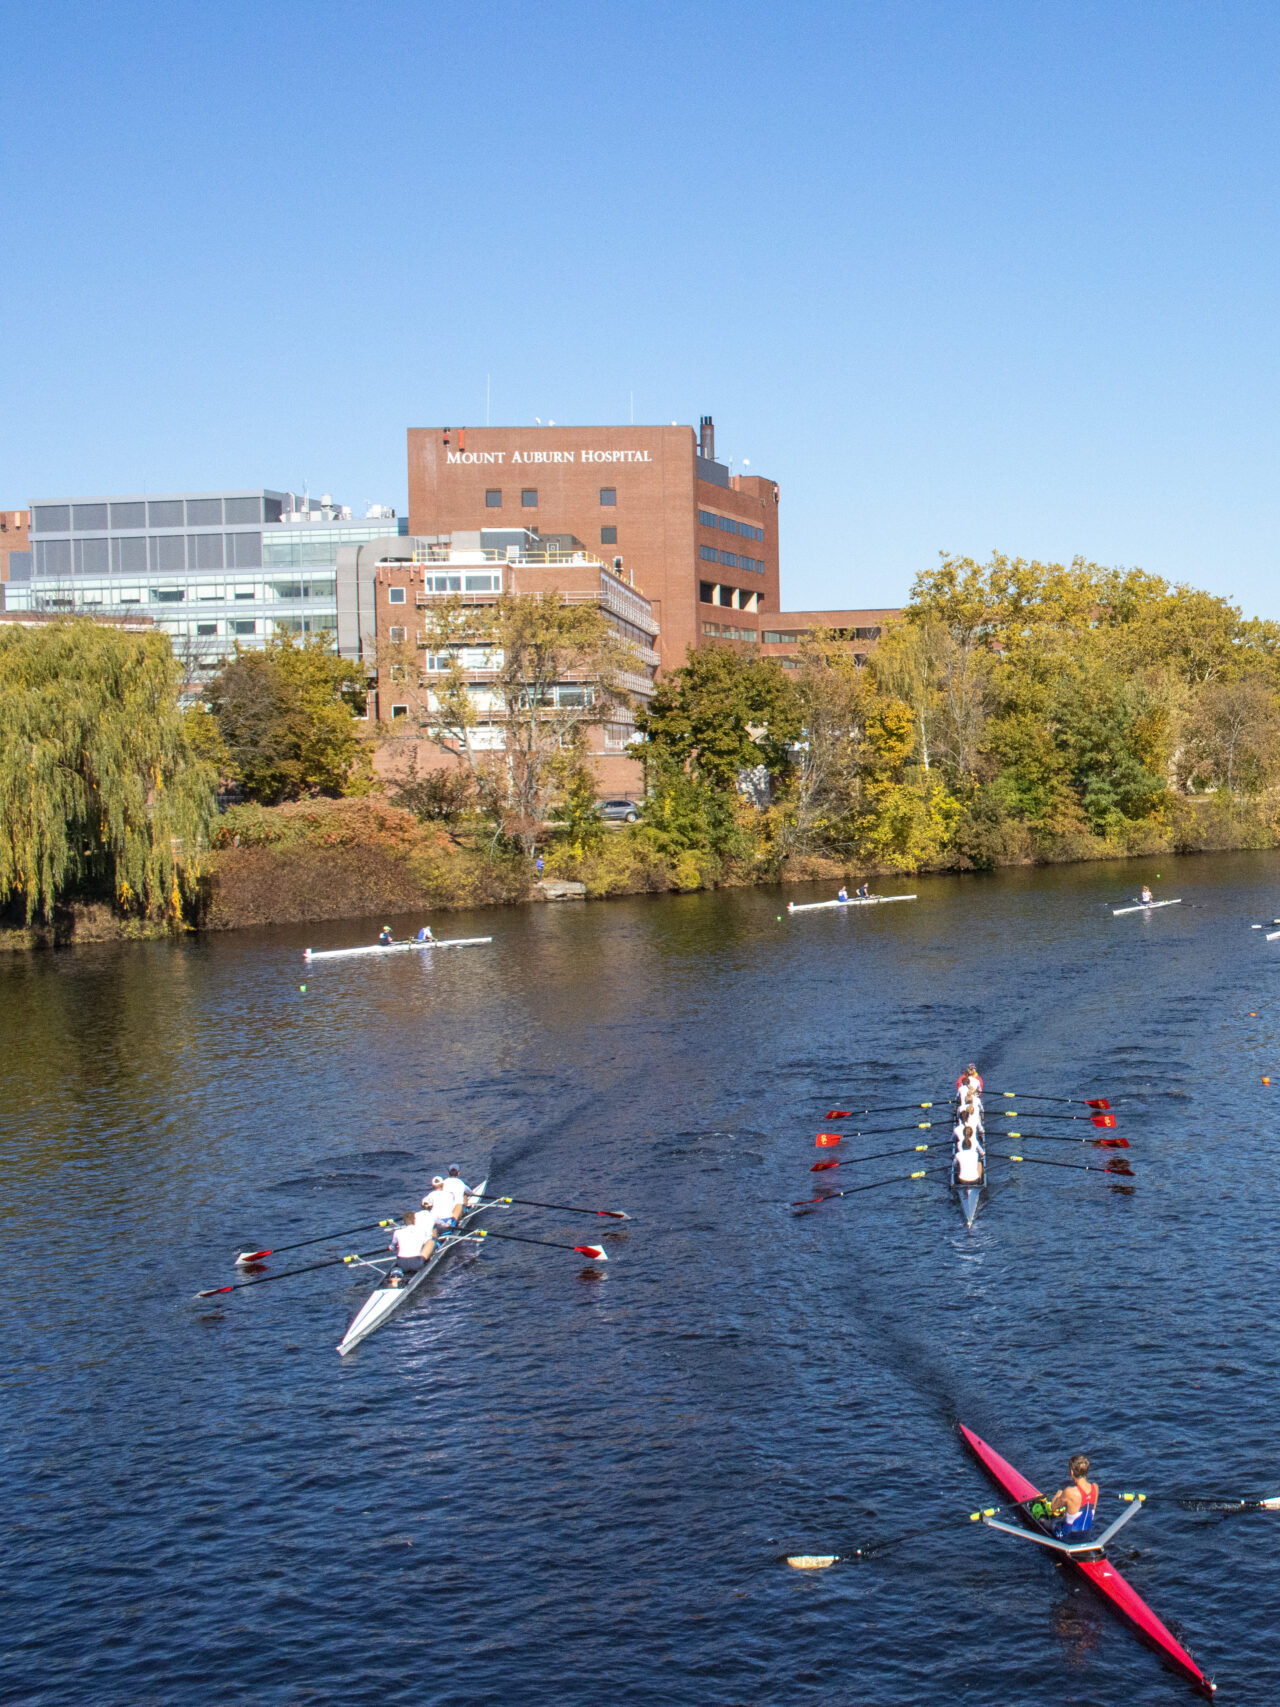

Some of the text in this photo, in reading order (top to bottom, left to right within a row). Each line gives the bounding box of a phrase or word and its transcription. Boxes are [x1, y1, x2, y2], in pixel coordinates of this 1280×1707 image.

[446, 449, 653, 464] MOUNT AUBURN HOSPITAL
